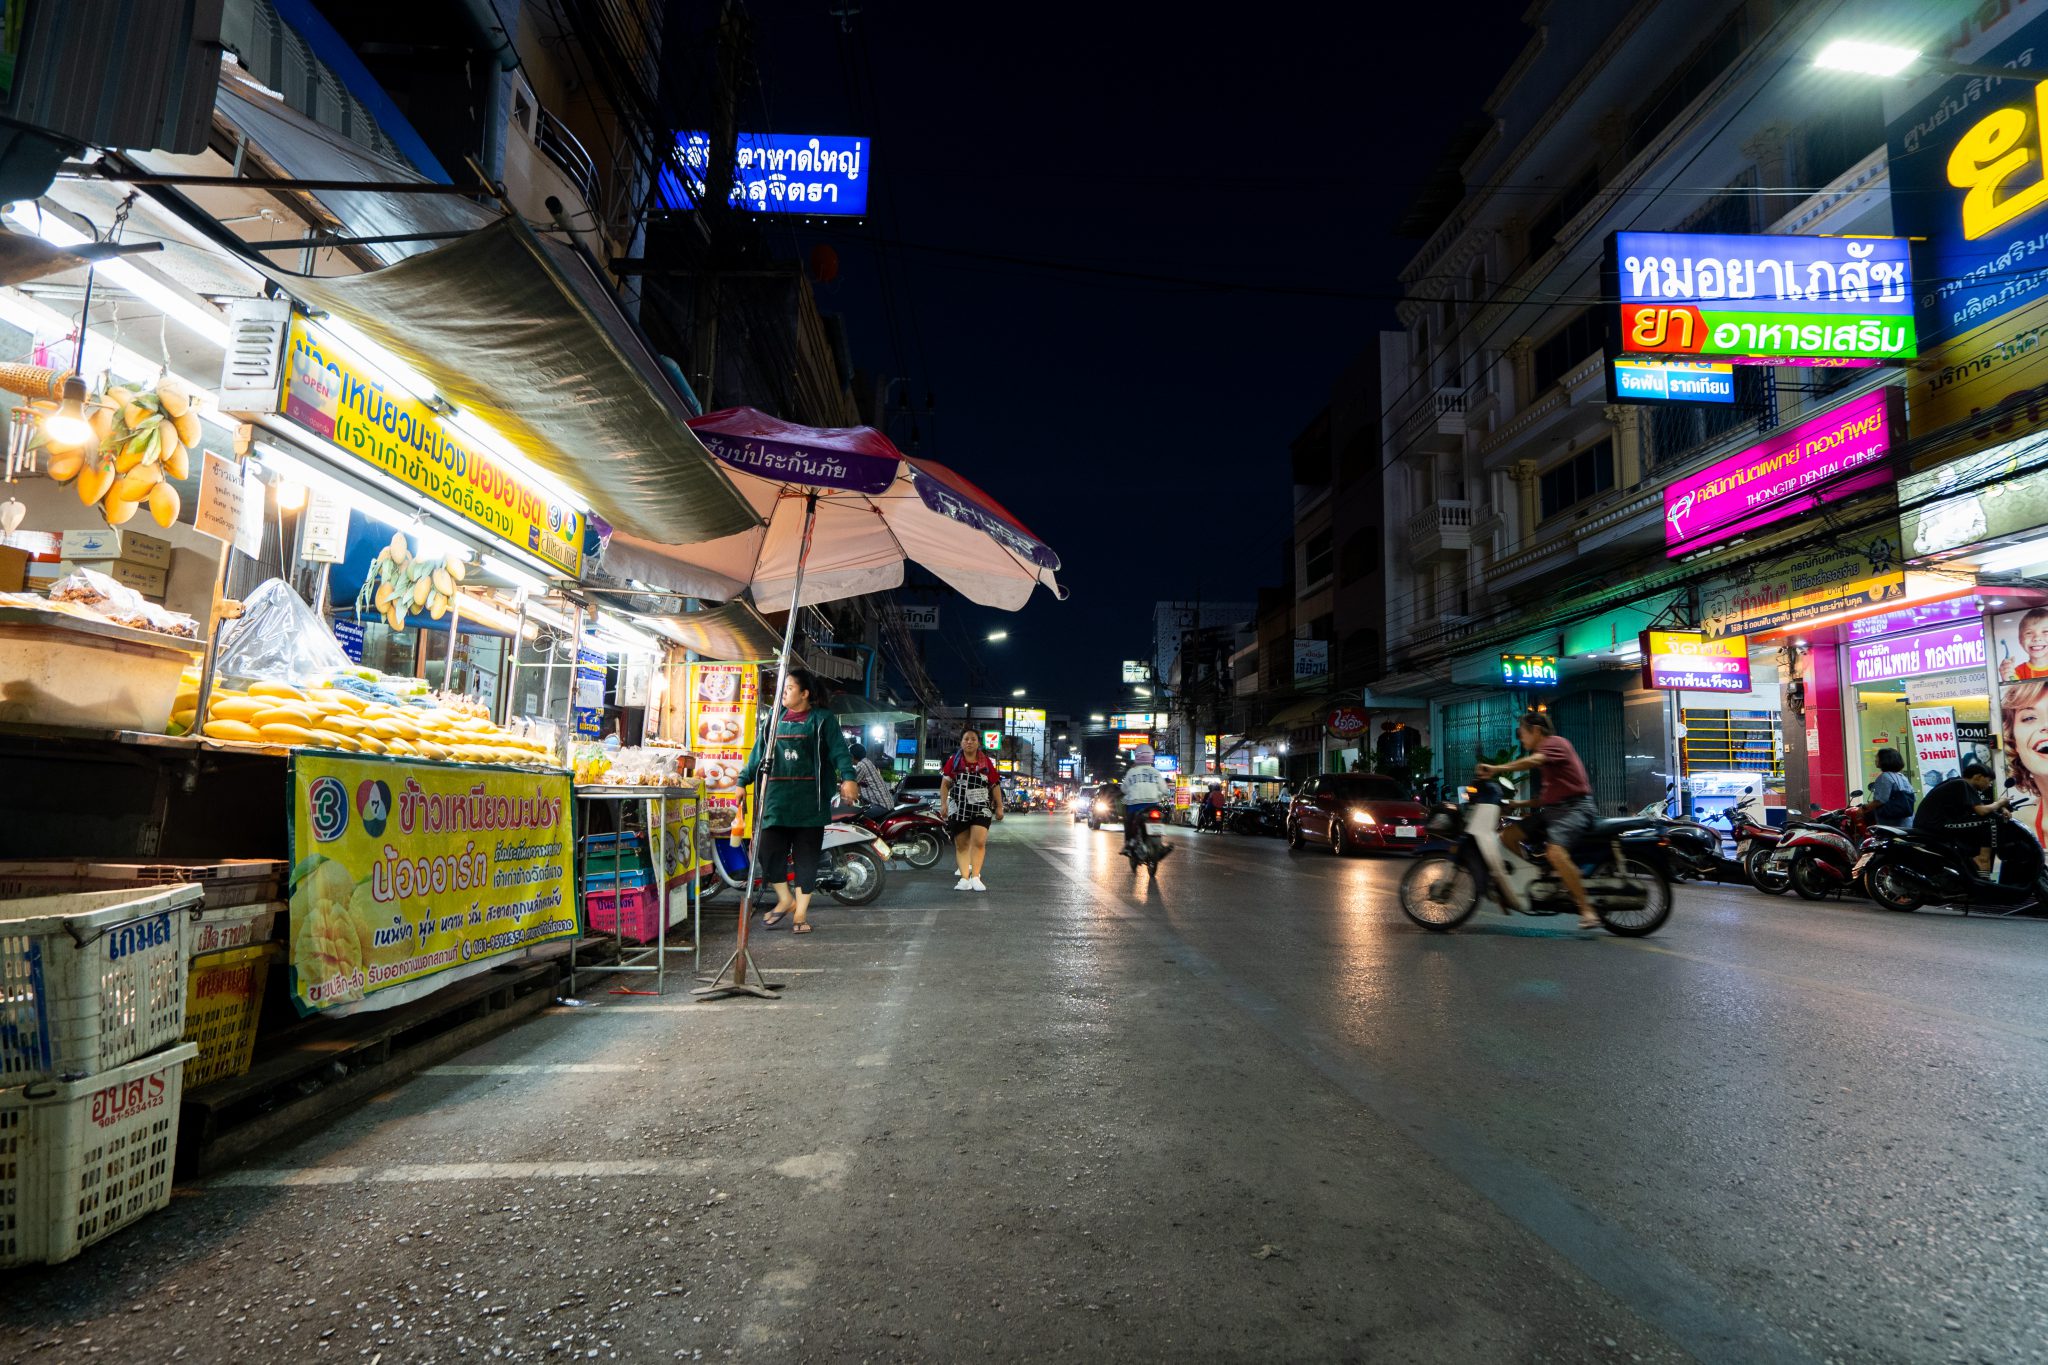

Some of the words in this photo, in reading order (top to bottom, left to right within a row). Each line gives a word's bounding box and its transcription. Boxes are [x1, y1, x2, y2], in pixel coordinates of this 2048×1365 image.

[1625, 242, 1904, 304] หมอยาเภสัช
[1921, 230, 2048, 309] อาหารเสริม
[1631, 308, 1694, 348] ยา
[1714, 320, 1906, 352] อาหารเสริม
[302, 374, 330, 398] OPEN
[1621, 372, 1663, 392] จัดฟัน
[1670, 378, 1731, 395] รากเทียม
[1697, 444, 1801, 503] คลินิกทันตแพทย์
[1805, 408, 1883, 458] ทองทิพย์
[1746, 478, 1797, 506] THONGTIP
[1799, 461, 1839, 487] DENTAL
[1843, 444, 1884, 470] CLINIC
[1856, 639, 1920, 679] ทันตแพทย์
[1917, 732, 1934, 743] 3M
[1935, 731, 1954, 742] N95
[1956, 727, 1988, 738] OOM!
[397, 776, 562, 835] ข้าวเหนียวมะม่วง
[371, 840, 488, 903] น้องอาร์ต
[374, 914, 414, 948] เหนียว
